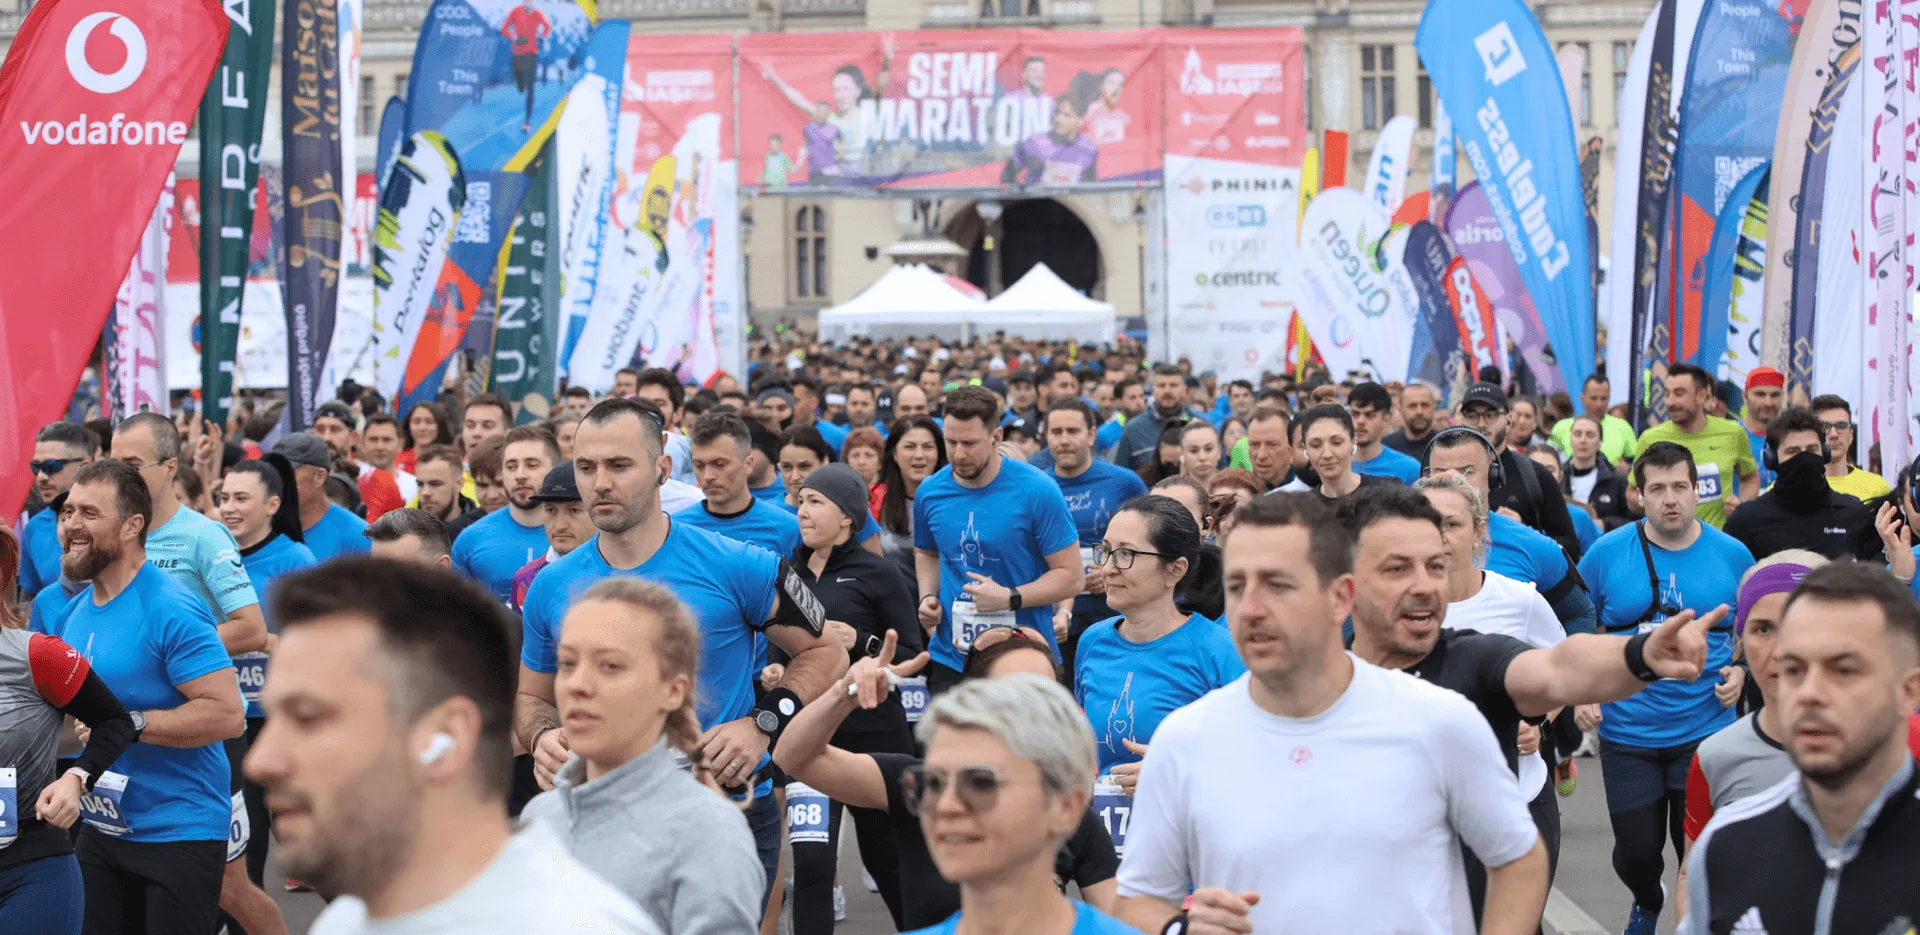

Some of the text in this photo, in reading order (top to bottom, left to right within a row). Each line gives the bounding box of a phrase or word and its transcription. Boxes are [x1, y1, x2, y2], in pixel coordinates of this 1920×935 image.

[907, 52, 998, 98] SEMI
[20, 113, 188, 146] vodafone
[860, 97, 1053, 148] MARATON
[1211, 178, 1294, 192] PHINIA
[1212, 270, 1280, 287] centric
